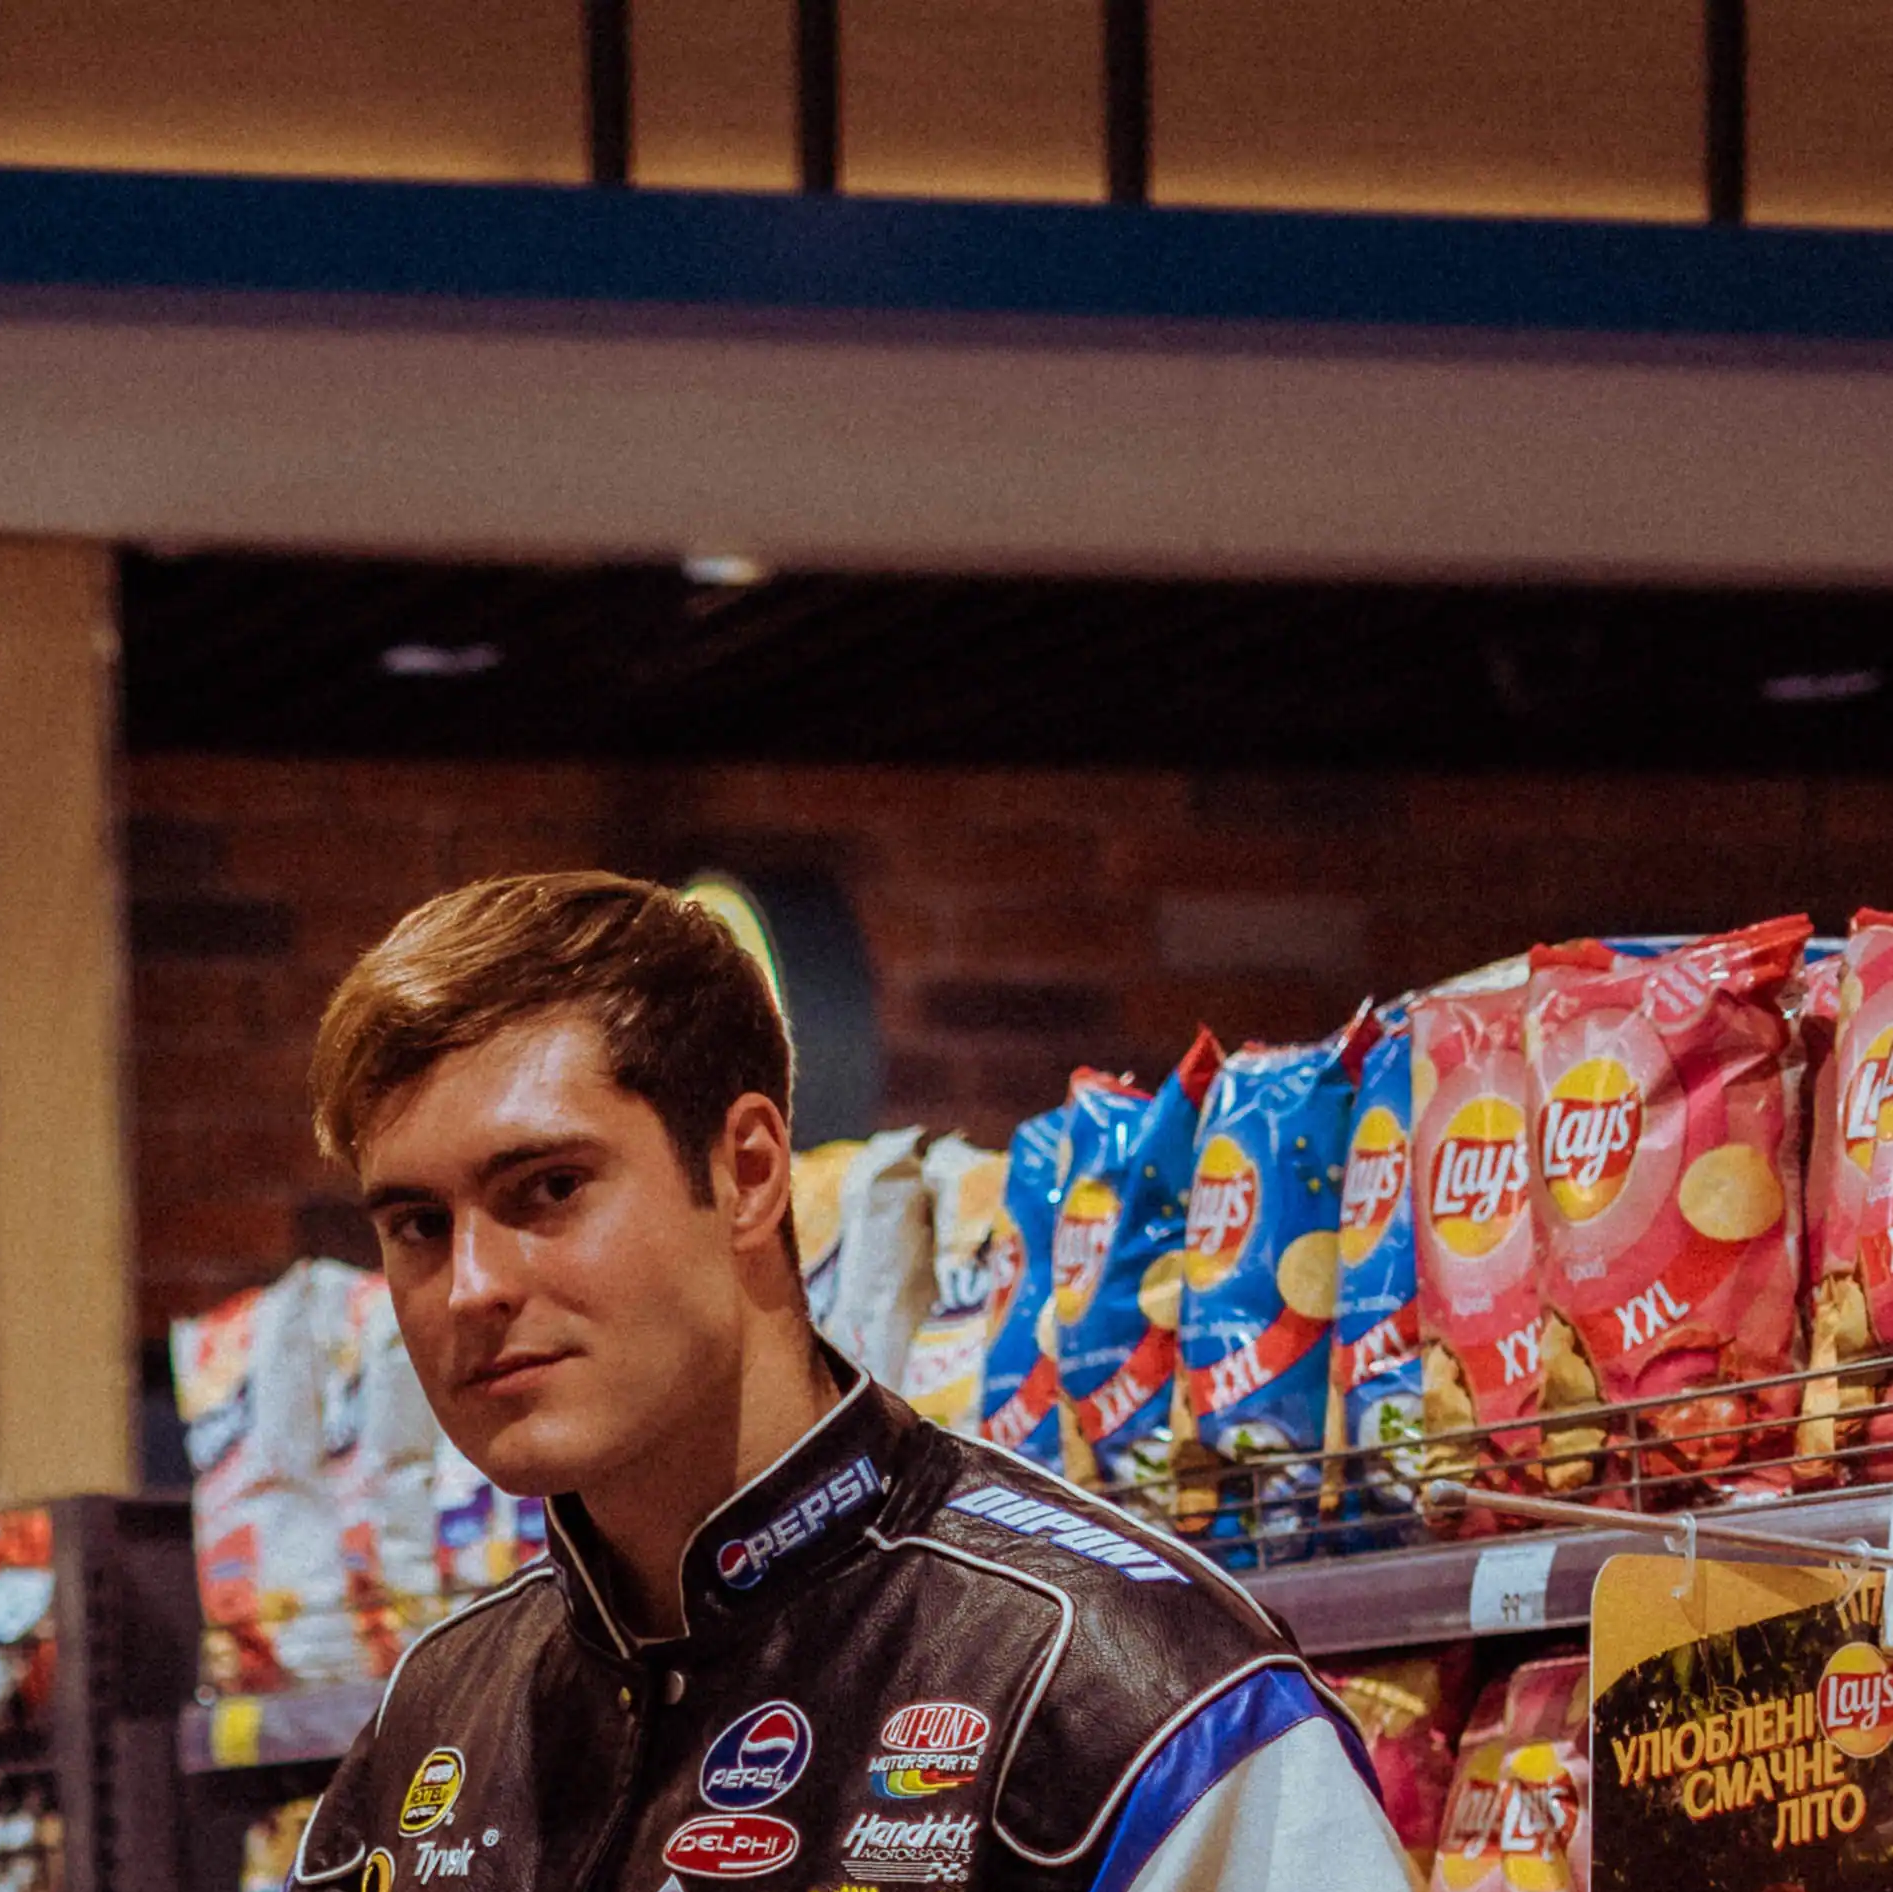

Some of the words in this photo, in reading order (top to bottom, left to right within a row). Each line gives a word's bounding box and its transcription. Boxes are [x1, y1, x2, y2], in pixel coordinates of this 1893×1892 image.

[1542, 1090, 1636, 1188] Lay's
[1434, 1130, 1530, 1224] Lay's
[1614, 1280, 1690, 1353] XXL
[745, 1456, 882, 1573] PEPSI
[946, 1485, 1192, 1586] DUPONT
[1827, 1666, 1893, 1731] Lay's
[868, 1752, 980, 1774] MOTORSPORTS
[1612, 1692, 1815, 1788] УЛЮБЛЕНІ
[706, 1767, 789, 1793] PEPSI
[1683, 1740, 1846, 1823] СМАЧНЕ
[677, 1835, 780, 1857] DELPHI
[843, 1811, 978, 1859] Hendrick
[1772, 1784, 1867, 1851] ЛІТО
